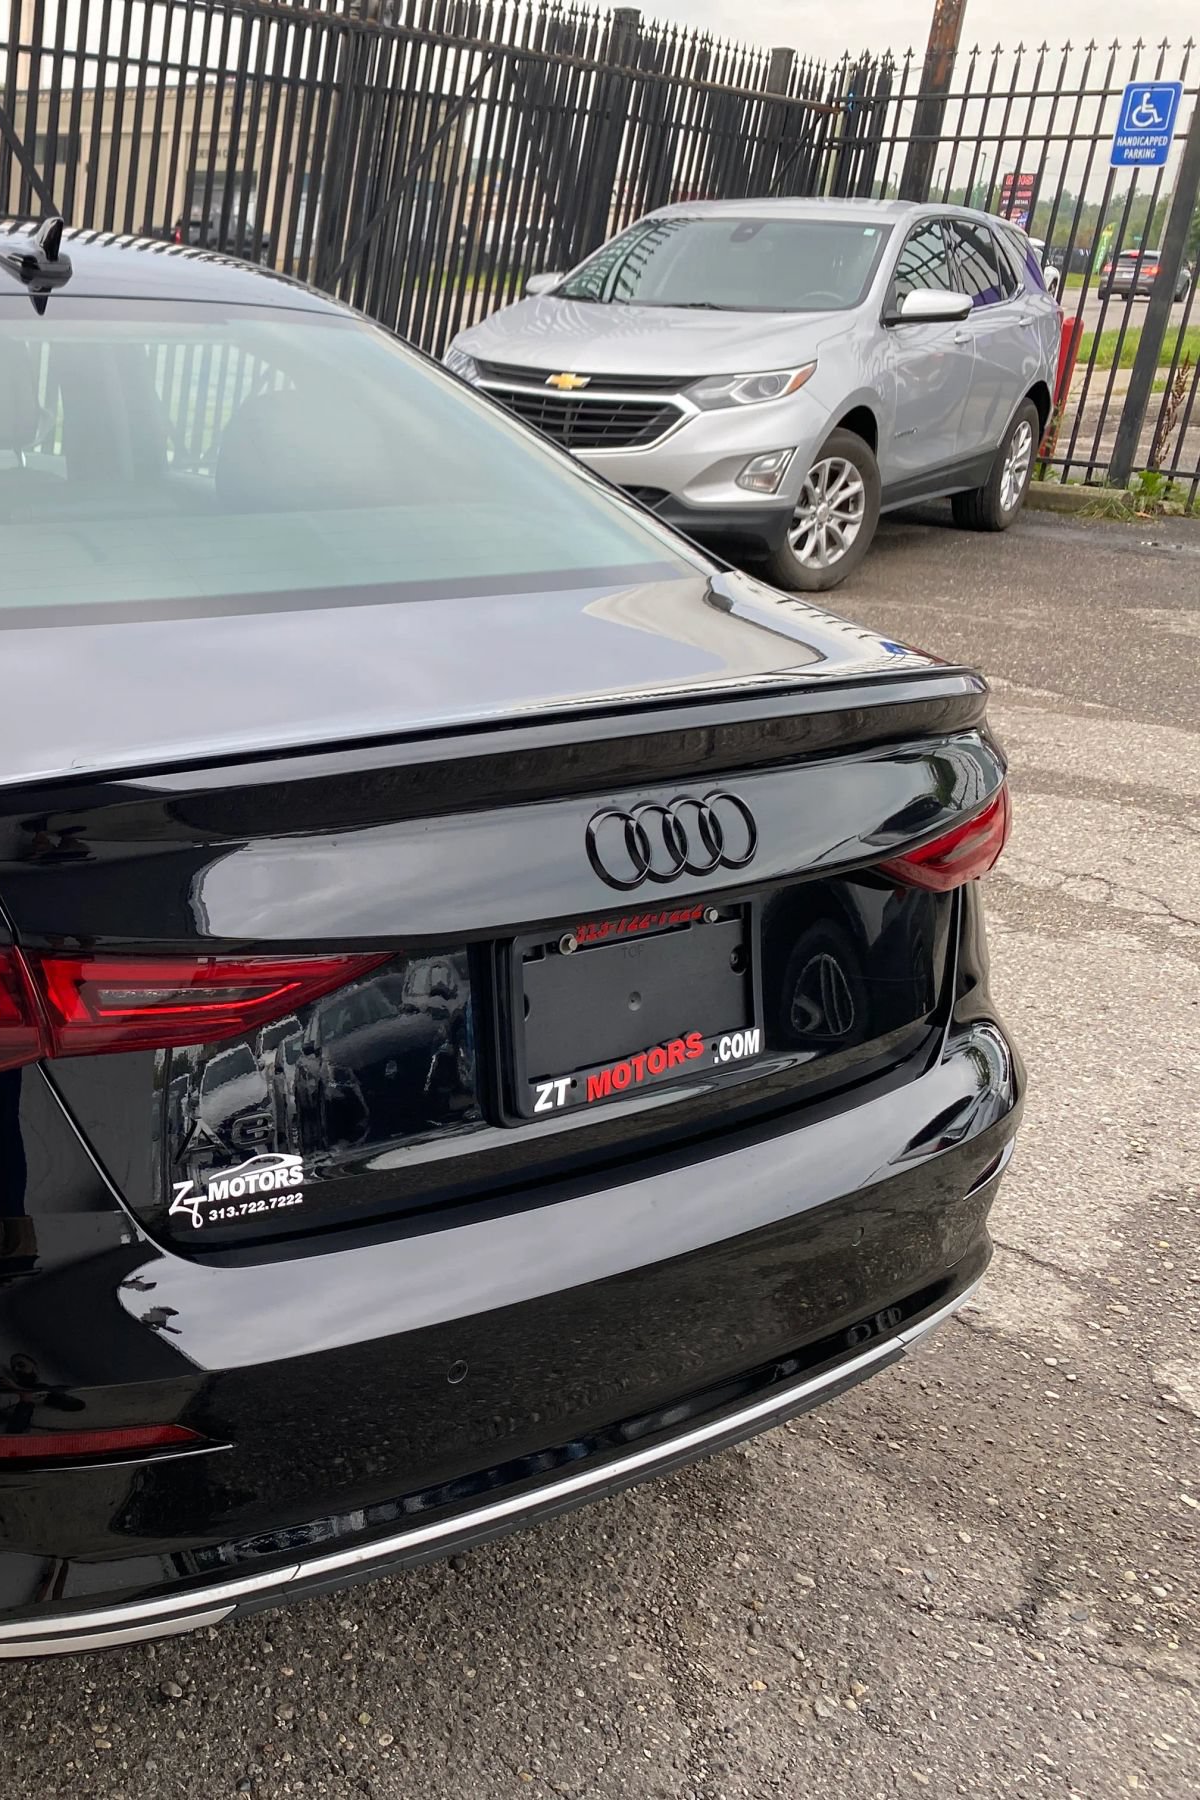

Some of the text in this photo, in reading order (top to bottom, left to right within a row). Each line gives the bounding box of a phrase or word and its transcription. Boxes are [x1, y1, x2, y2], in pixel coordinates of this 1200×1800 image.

[1116, 136, 1168, 147] HANDICAPPED
[1123, 149, 1157, 159] PARKING
[534, 1029, 760, 1113] ZT MOTORS .COM
[207, 1165, 304, 1202] MOTORS
[208, 1192, 304, 1221] 313.722.7222
